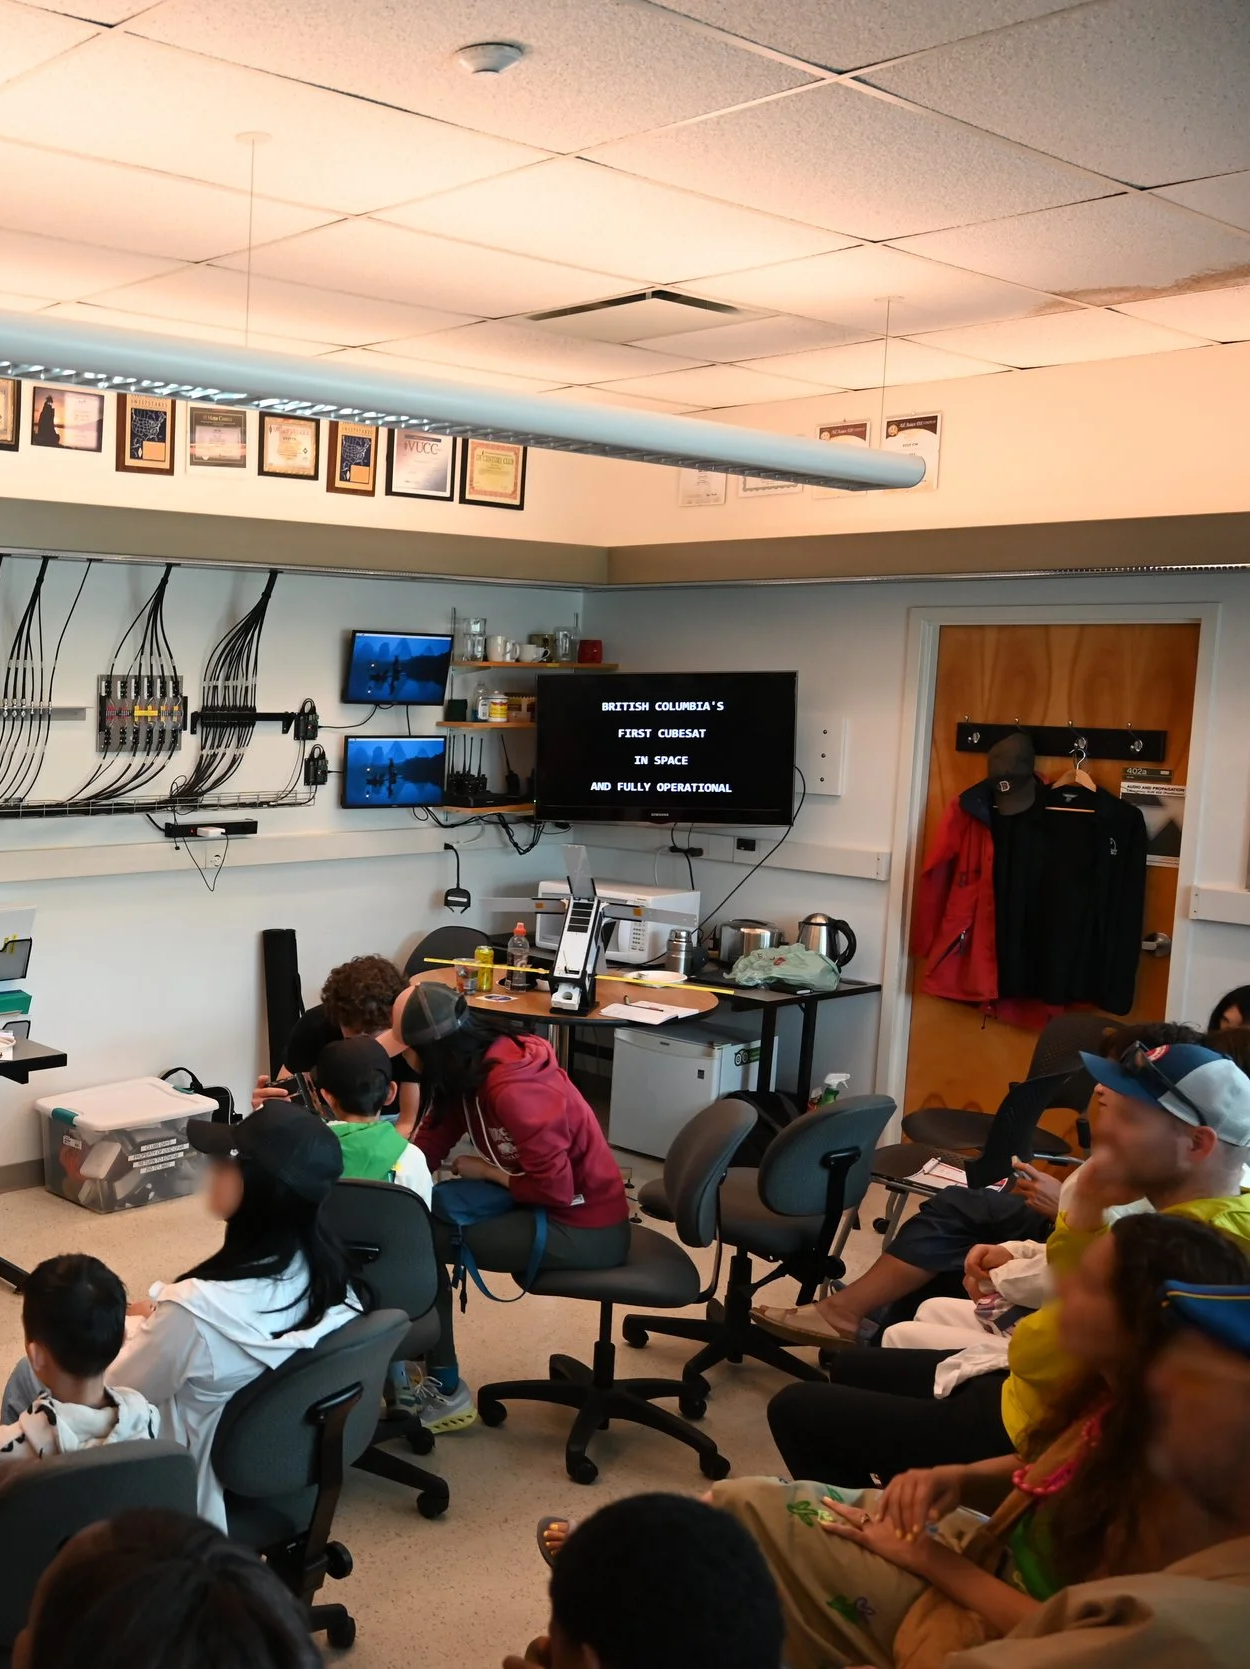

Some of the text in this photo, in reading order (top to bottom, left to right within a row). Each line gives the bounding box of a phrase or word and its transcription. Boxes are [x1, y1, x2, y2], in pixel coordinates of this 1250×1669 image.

[131, 399, 168, 408] SWEEPSTAKES
[408, 441, 439, 455] VUCC
[502, 457, 514, 466] CLUB
[601, 701, 724, 712] BRITISH COLUMBIA'S
[618, 728, 706, 738] FIRST CUBESAT
[634, 756, 688, 765] IN SPACE
[1126, 767, 1147, 775] 402a
[590, 782, 732, 793] AND FULLY OPERATIONAL
